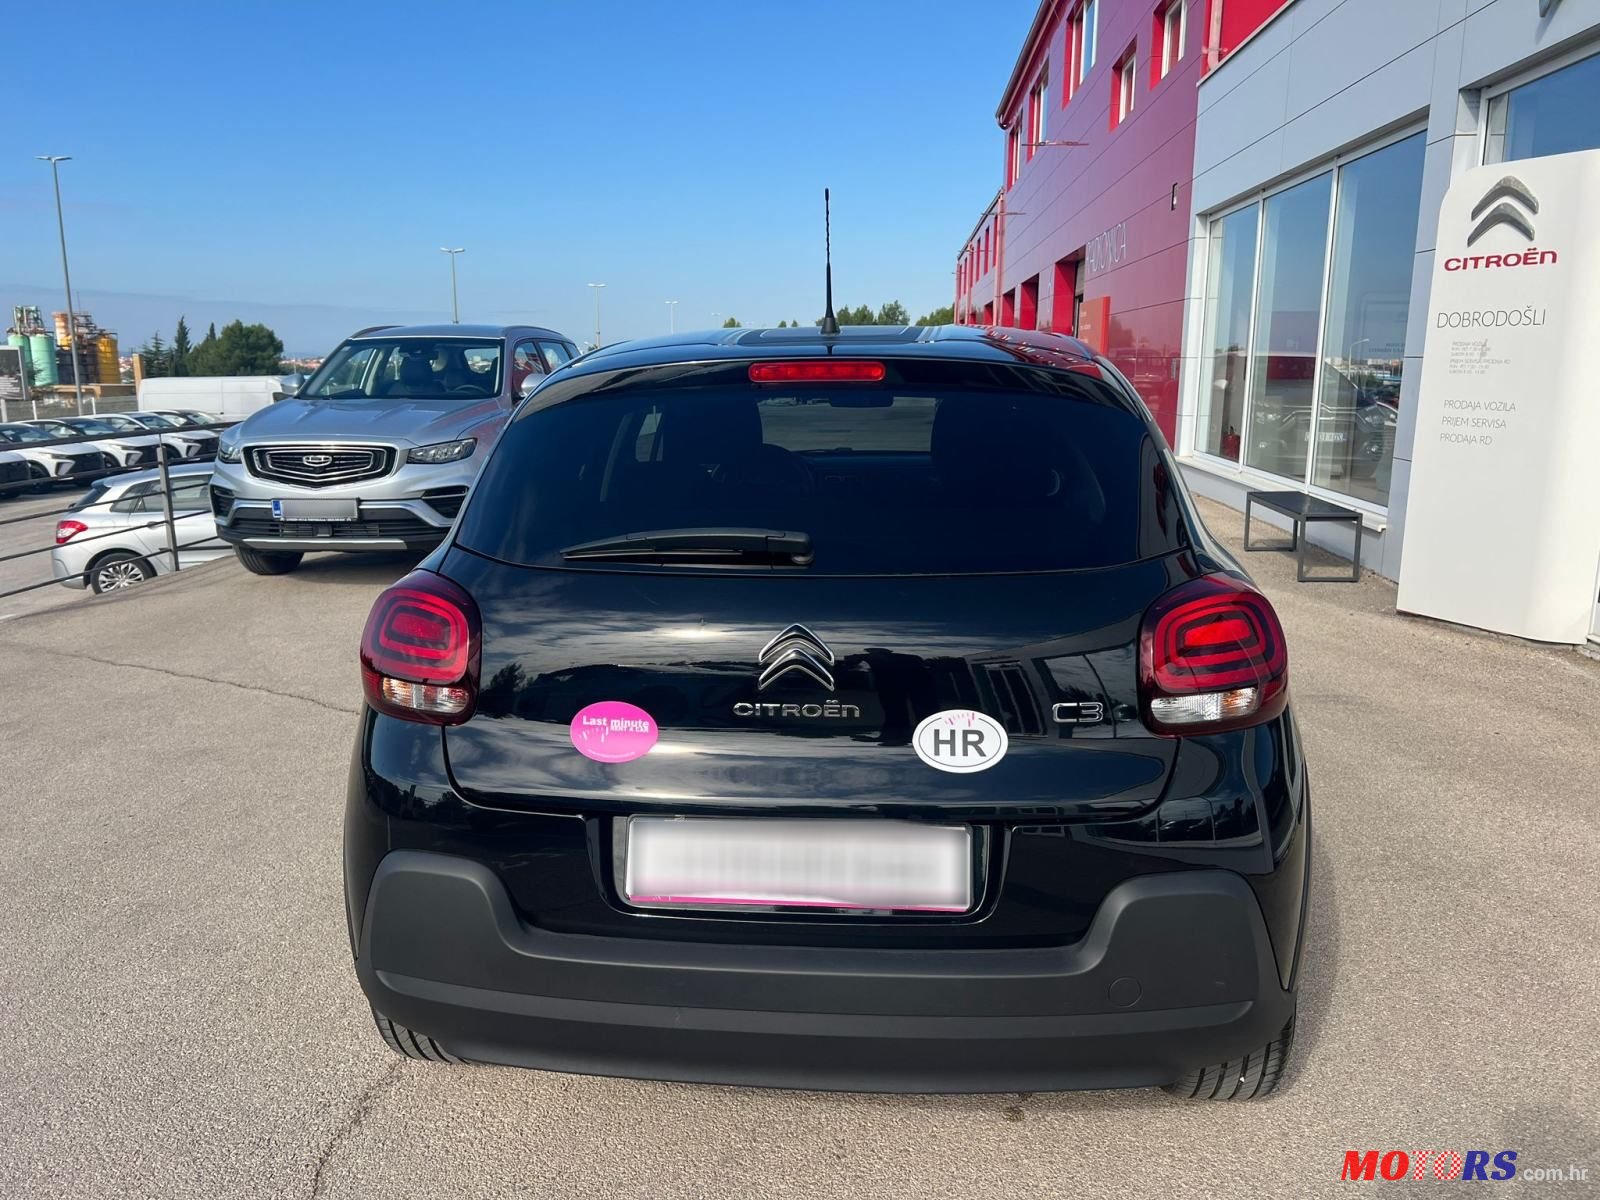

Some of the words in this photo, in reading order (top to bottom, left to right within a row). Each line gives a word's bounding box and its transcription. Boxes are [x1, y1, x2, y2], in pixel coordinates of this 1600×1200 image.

[1444, 248, 1557, 271] CITROËN
[1437, 305, 1546, 328] DOBRODOŠLI
[1444, 400, 1481, 411] PRODAJA
[1484, 401, 1516, 411] VOZILA
[1442, 416, 1469, 427] PRIJEM
[1471, 418, 1506, 429] SERVISA
[1440, 433, 1477, 444] PRODAJA
[1480, 436, 1493, 445] RD
[733, 700, 860, 718] CITROËN
[1052, 702, 1103, 722] C3
[582, 715, 607, 726] Last
[610, 718, 649, 728] minute
[933, 729, 987, 757] HR
